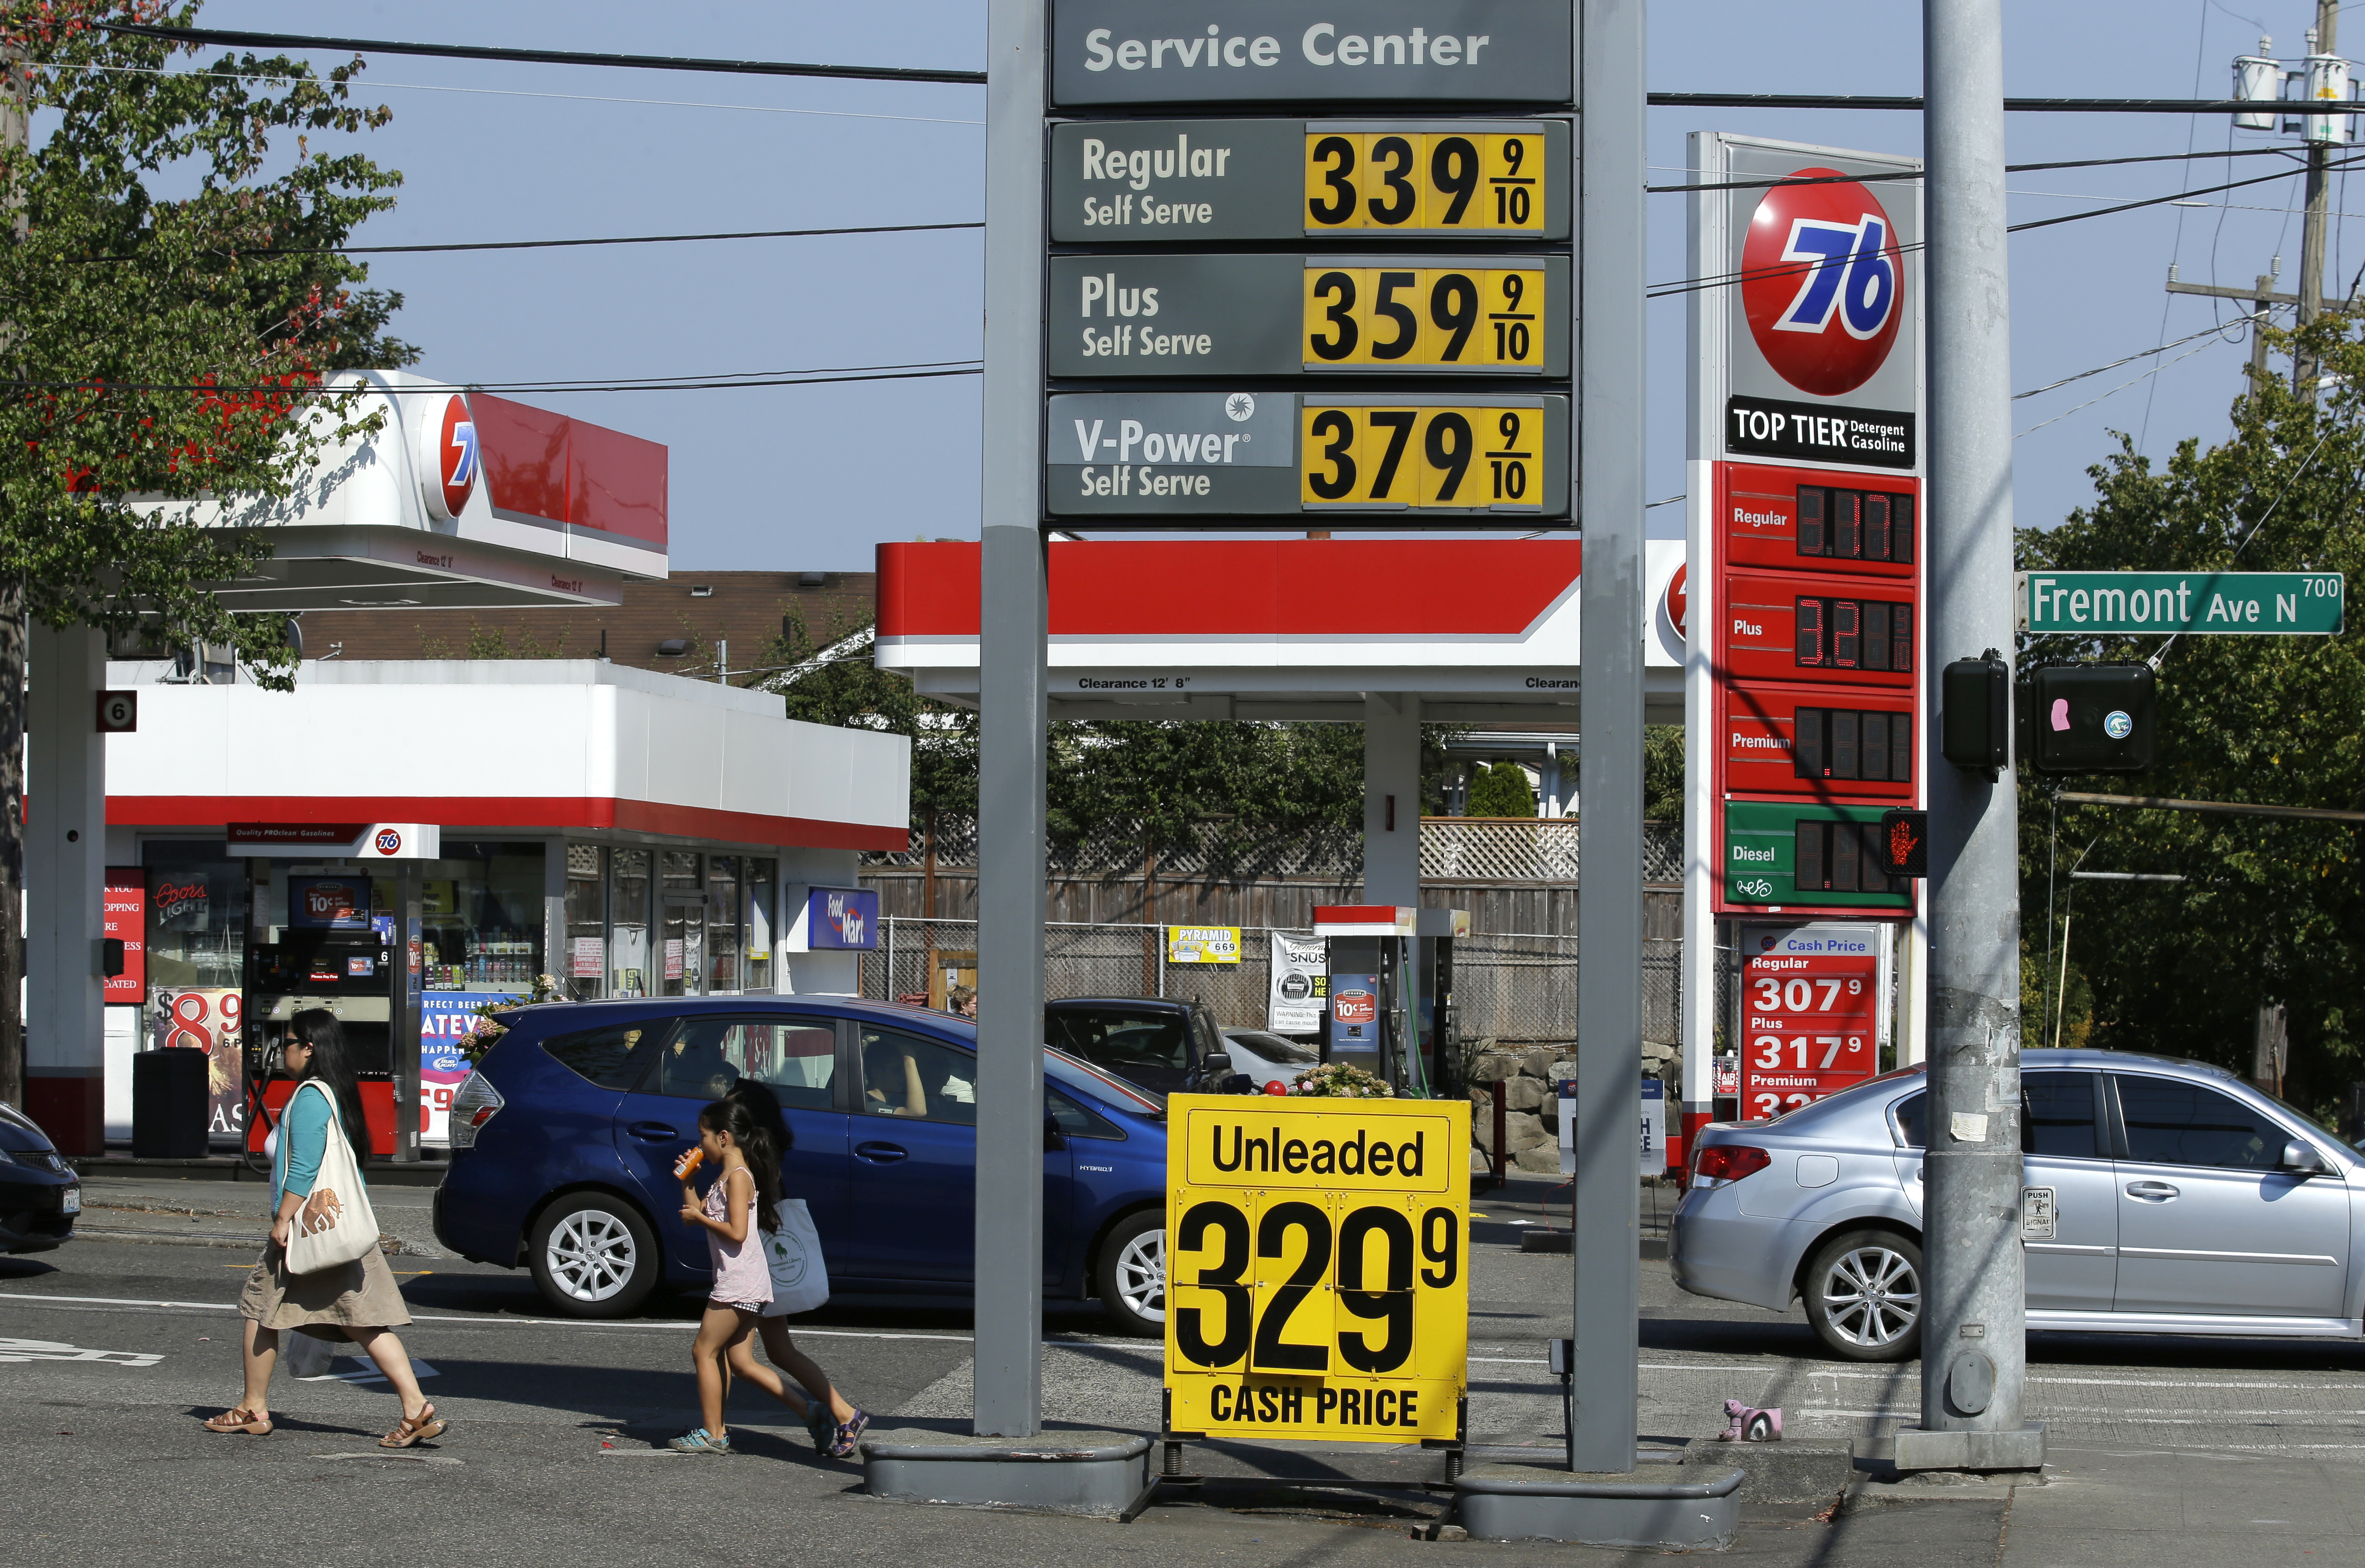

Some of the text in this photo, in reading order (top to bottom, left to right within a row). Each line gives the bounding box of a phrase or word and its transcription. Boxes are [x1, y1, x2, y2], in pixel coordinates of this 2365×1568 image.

[1084, 22, 1490, 72] Service Center
[1083, 134, 1231, 191] Regular
[1308, 136, 1481, 225] 339
[1083, 194, 1213, 227] Self Serve
[1772, 213, 1896, 341] 76
[1081, 272, 1159, 318] Plus
[1310, 271, 1479, 362] 359
[1082, 324, 1212, 357] Self Serve
[1733, 409, 1785, 441] TOP
[1850, 420, 1905, 437] Detergent
[1851, 435, 1905, 452] Gasoline
[1308, 409, 1474, 501] 379
[1080, 465, 1211, 496] Self Serve
[1734, 508, 1787, 528] Regular
[416, 551, 440, 568] Clearance
[551, 574, 571, 591] Clearance
[2034, 578, 2339, 623] Fremont Ave N 700
[1734, 619, 1763, 636] Plus
[1079, 677, 1148, 689] Clearance
[111, 703, 126, 721] 6
[1732, 732, 1791, 749] Premium
[378, 833, 399, 849] 76
[1733, 846, 1775, 862] Diesel
[113, 884, 133, 893] YOU
[153, 883, 207, 907] Coors
[159, 899, 207, 926] LIGHT
[828, 894, 844, 919] Food
[842, 913, 864, 944] Mart
[1179, 929, 1232, 941] PYRAMID
[1215, 943, 1235, 951] 669
[1763, 939, 1774, 948] 76
[1787, 939, 1866, 952] Cash Price
[381, 951, 388, 962] 6
[1290, 952, 1326, 964] SNUS
[1752, 957, 1809, 972] Regular
[1314, 977, 1326, 986] SO
[1314, 987, 1326, 997] HE
[1753, 978, 1842, 1012] 307
[423, 1000, 454, 1009] RFECT
[421, 1014, 486, 1035] ATEV
[1751, 1017, 1783, 1029] Plus
[223, 1038, 230, 1048] 6
[421, 1045, 471, 1054] HAPPEN
[1754, 1035, 1842, 1069] 317
[1722, 1073, 1735, 1081] AIR
[1751, 1075, 1817, 1087] Premium
[1568, 1084, 1576, 1093] 76
[1212, 1124, 1424, 1178] Unleaded
[768, 1259, 788, 1267] Greenwood
[1175, 1200, 1415, 1374] 329
[1210, 1384, 1419, 1427] CASH PRICE
